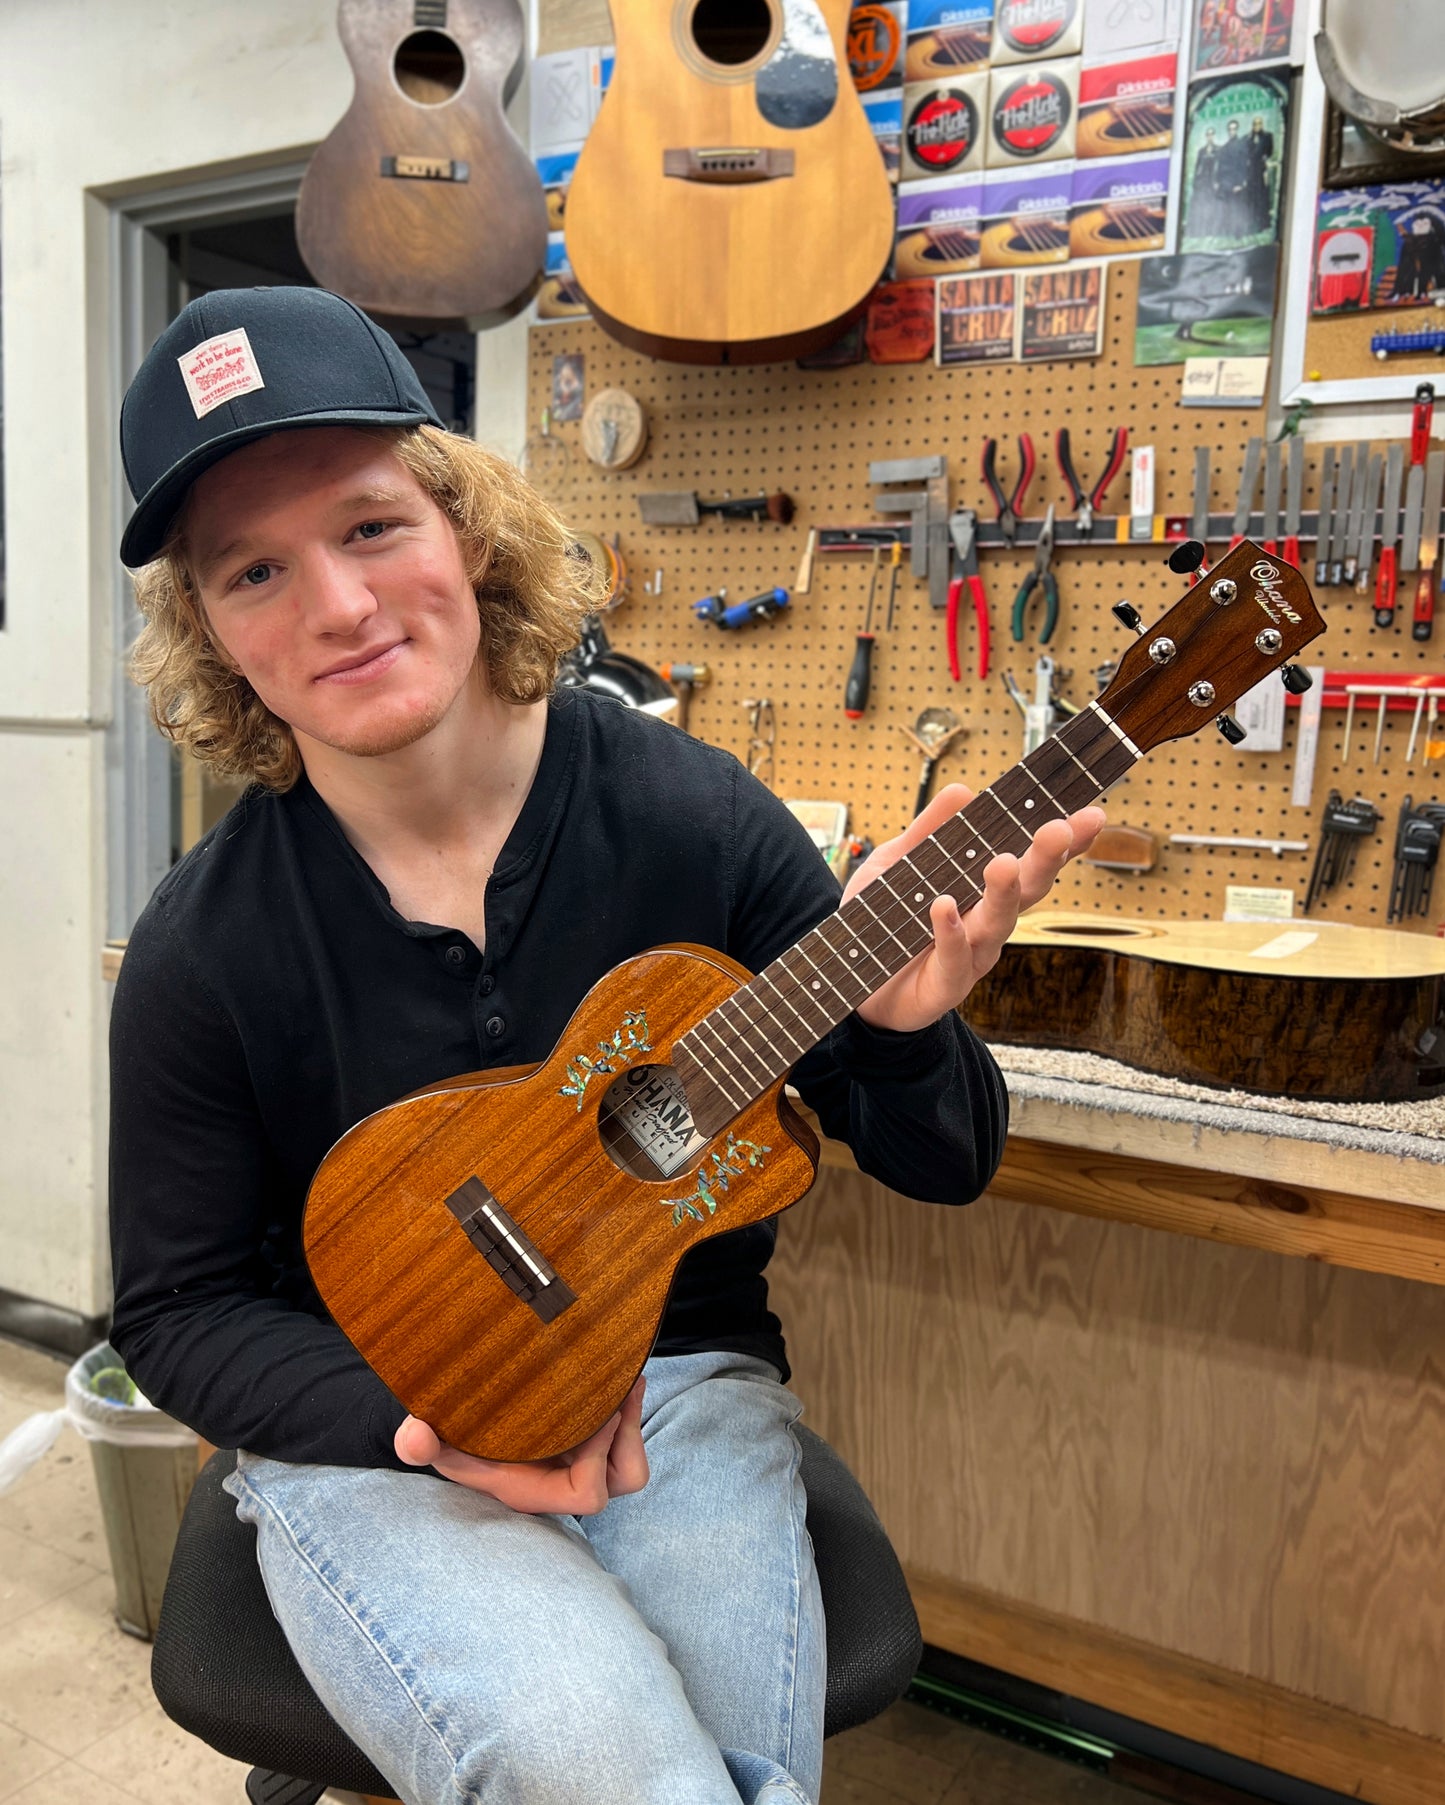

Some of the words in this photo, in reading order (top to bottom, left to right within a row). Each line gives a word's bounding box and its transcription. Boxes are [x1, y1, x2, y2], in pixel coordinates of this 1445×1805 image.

[941, 274, 1015, 312] SANTA
[1025, 267, 1102, 305] SANTA
[952, 310, 1015, 342] CRUZ
[1036, 305, 1099, 337] CRUZ
[189, 360, 206, 376] work
[206, 358, 214, 366] to
[213, 351, 223, 362] be
[224, 346, 243, 357] done
[1250, 560, 1302, 624] Ohana
[627, 1064, 697, 1147] OHANA
[664, 1077, 691, 1111] CK-60
